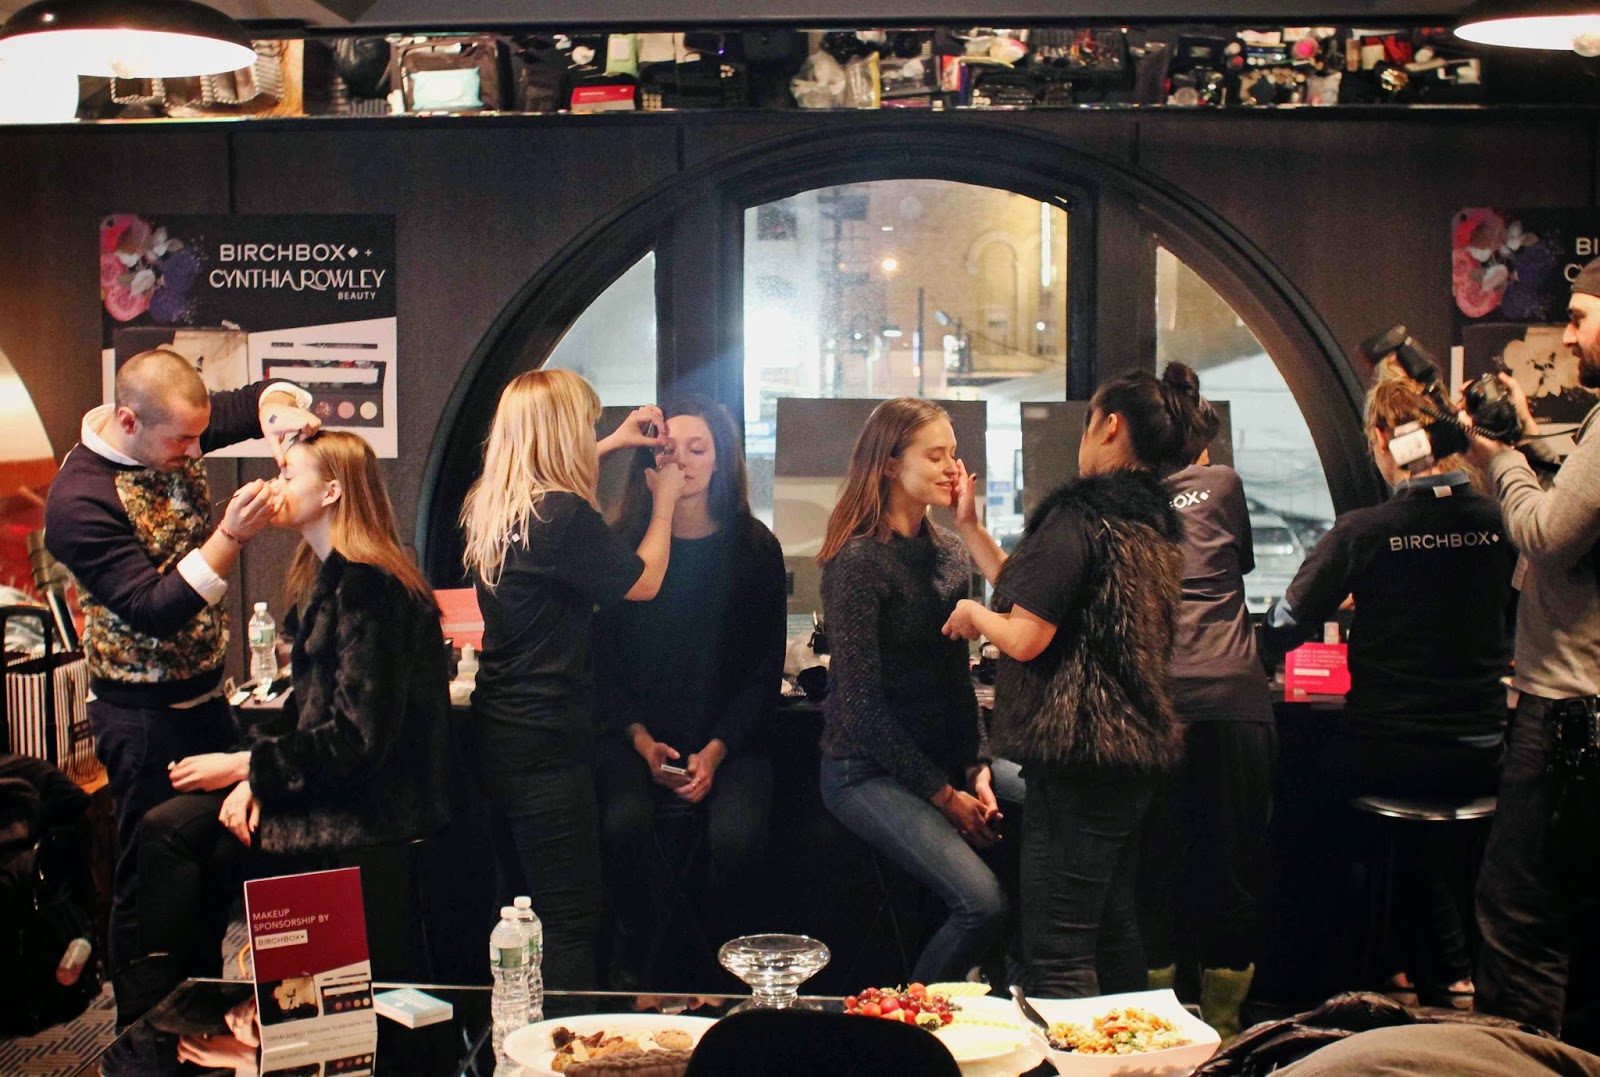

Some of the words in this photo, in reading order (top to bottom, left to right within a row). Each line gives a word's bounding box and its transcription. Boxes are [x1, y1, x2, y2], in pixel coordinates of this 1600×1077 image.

[219, 243, 346, 262] BIRCHBOX
[209, 269, 303, 291] CYNTHIA
[300, 269, 386, 291] ROWLEY
[337, 291, 376, 300] BEAUTY
[1169, 490, 1200, 509] OX
[1389, 531, 1491, 552] BIRCHBOX
[252, 908, 290, 921] MAKEUP
[253, 915, 316, 932] SPONSORSHIP
[318, 914, 329, 923] BY
[257, 934, 301, 947] BIRCHBOX
